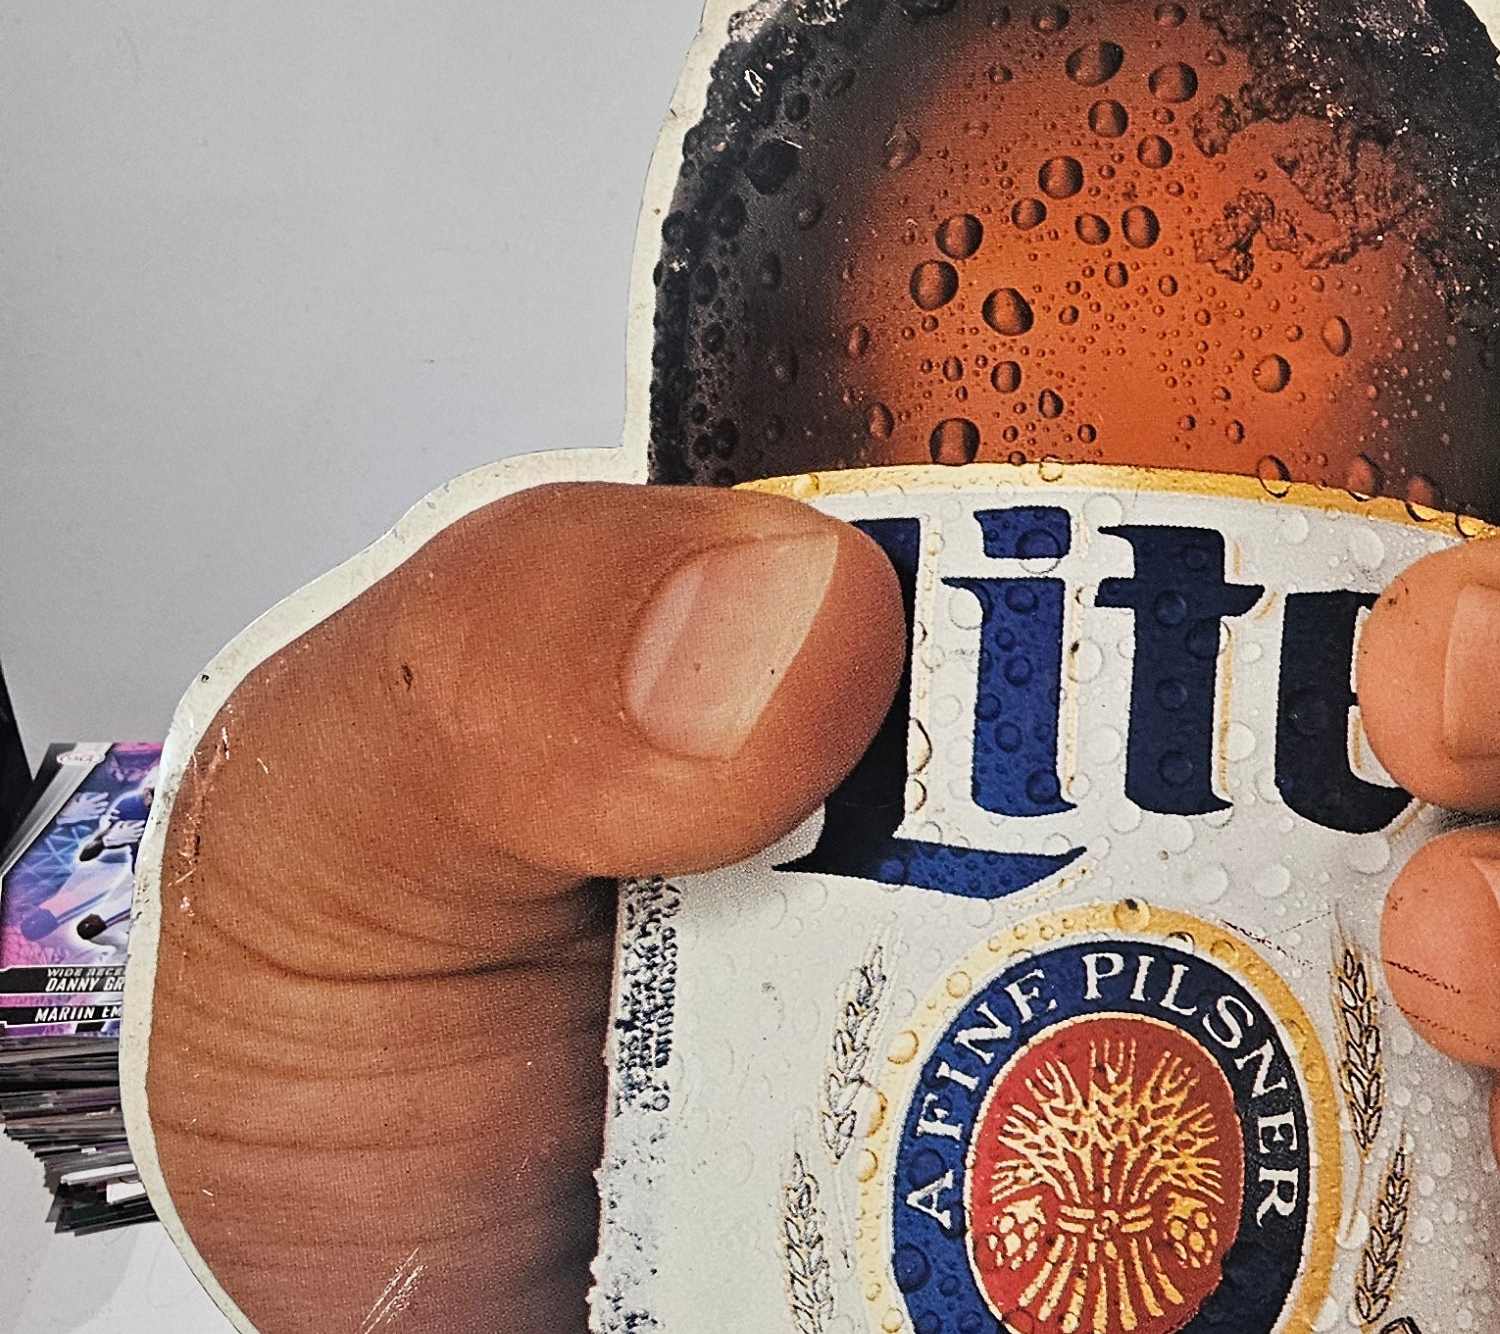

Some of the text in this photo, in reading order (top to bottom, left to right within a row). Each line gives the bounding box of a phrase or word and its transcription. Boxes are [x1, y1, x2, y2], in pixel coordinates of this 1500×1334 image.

[47, 968, 82, 977] WIDE
[46, 978, 100, 992] DANNY
[906, 952, 1298, 1230] A FINE PILSNER
